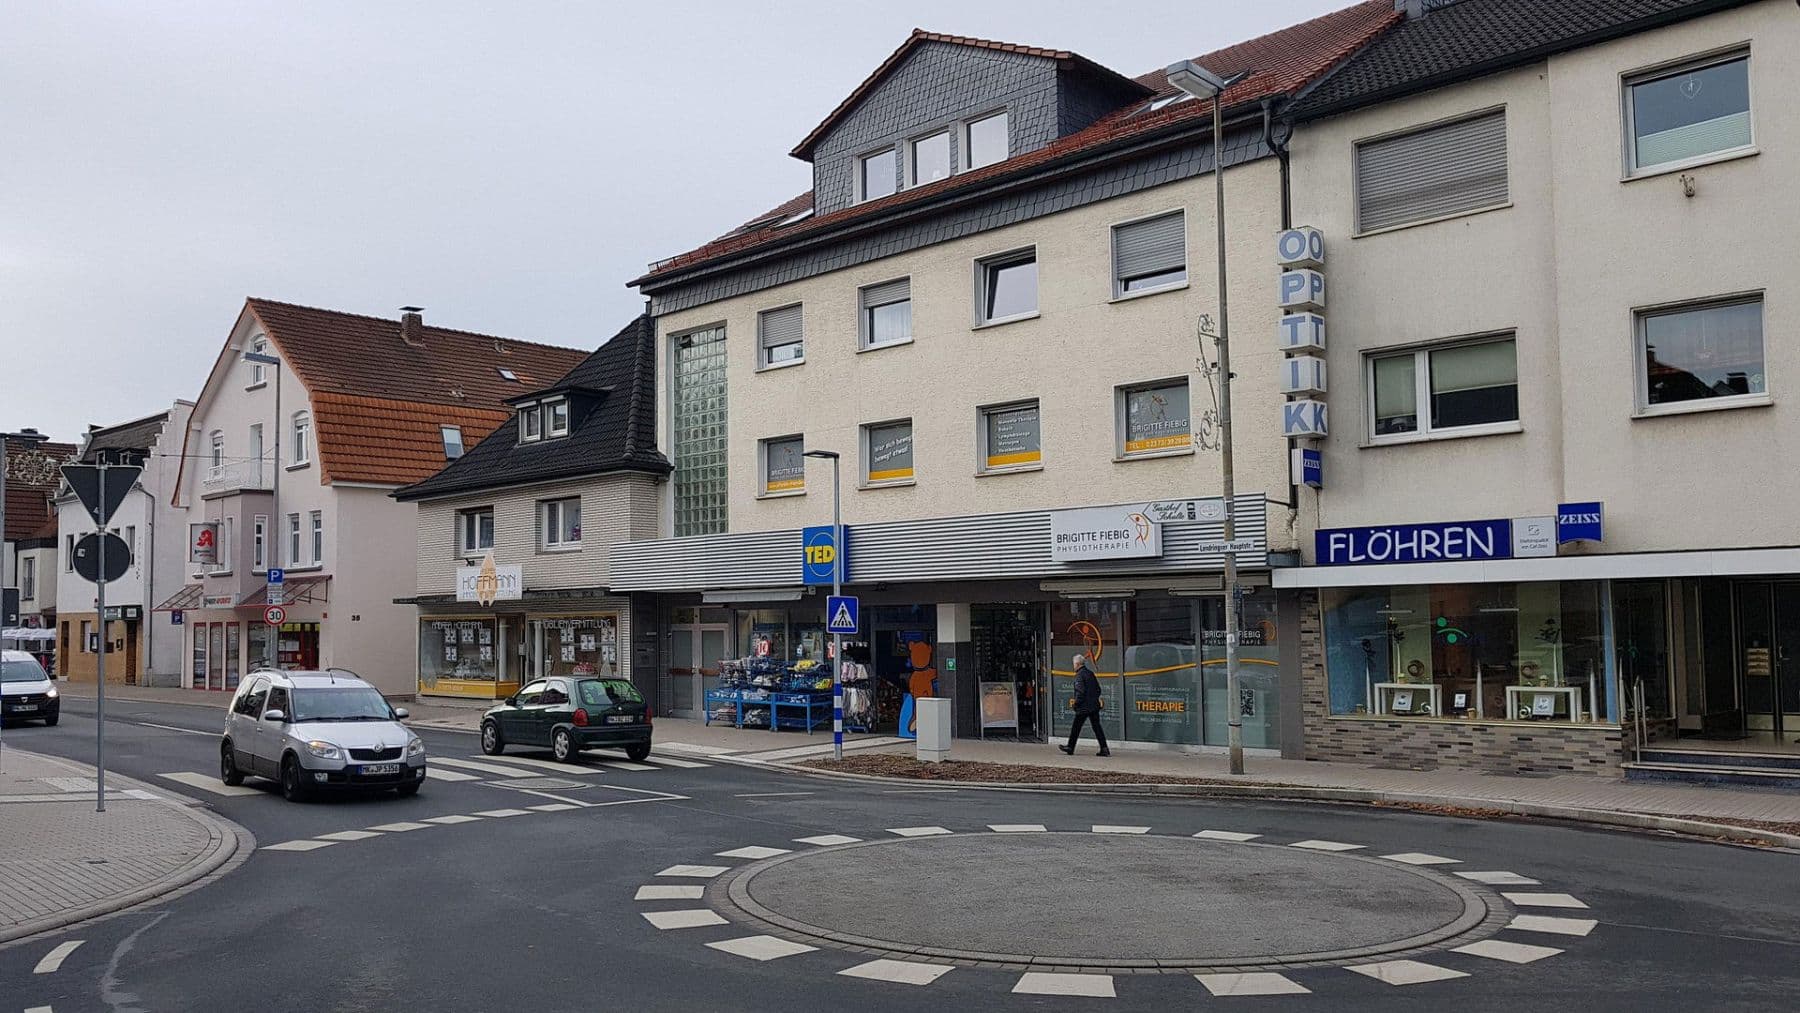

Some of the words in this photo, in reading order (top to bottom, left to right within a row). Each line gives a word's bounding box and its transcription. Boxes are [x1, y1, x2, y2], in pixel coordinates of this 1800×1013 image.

[1279, 230, 1311, 433] OPTIK
[1132, 422, 1163, 433] BRIGITTE
[1164, 419, 1187, 428] FIEBIG
[1303, 458, 1320, 469] ZEISS
[1152, 502, 1183, 512] Gasthof
[1157, 511, 1185, 521] Schulte
[1559, 513, 1600, 525] ZEISS
[1057, 531, 1097, 543] BRIGITTE
[1100, 529, 1130, 540] FIEBIG
[1056, 542, 1130, 552] PHYSIOTHERAPIE
[1329, 526, 1495, 563] FLÖHREN
[805, 545, 835, 565] TED
[271, 570, 280, 581] P
[462, 574, 517, 590] HOFFMANN
[269, 611, 281, 620] 30
[1237, 630, 1261, 638] FIEBIG
[1135, 700, 1185, 712] THERAPIE
